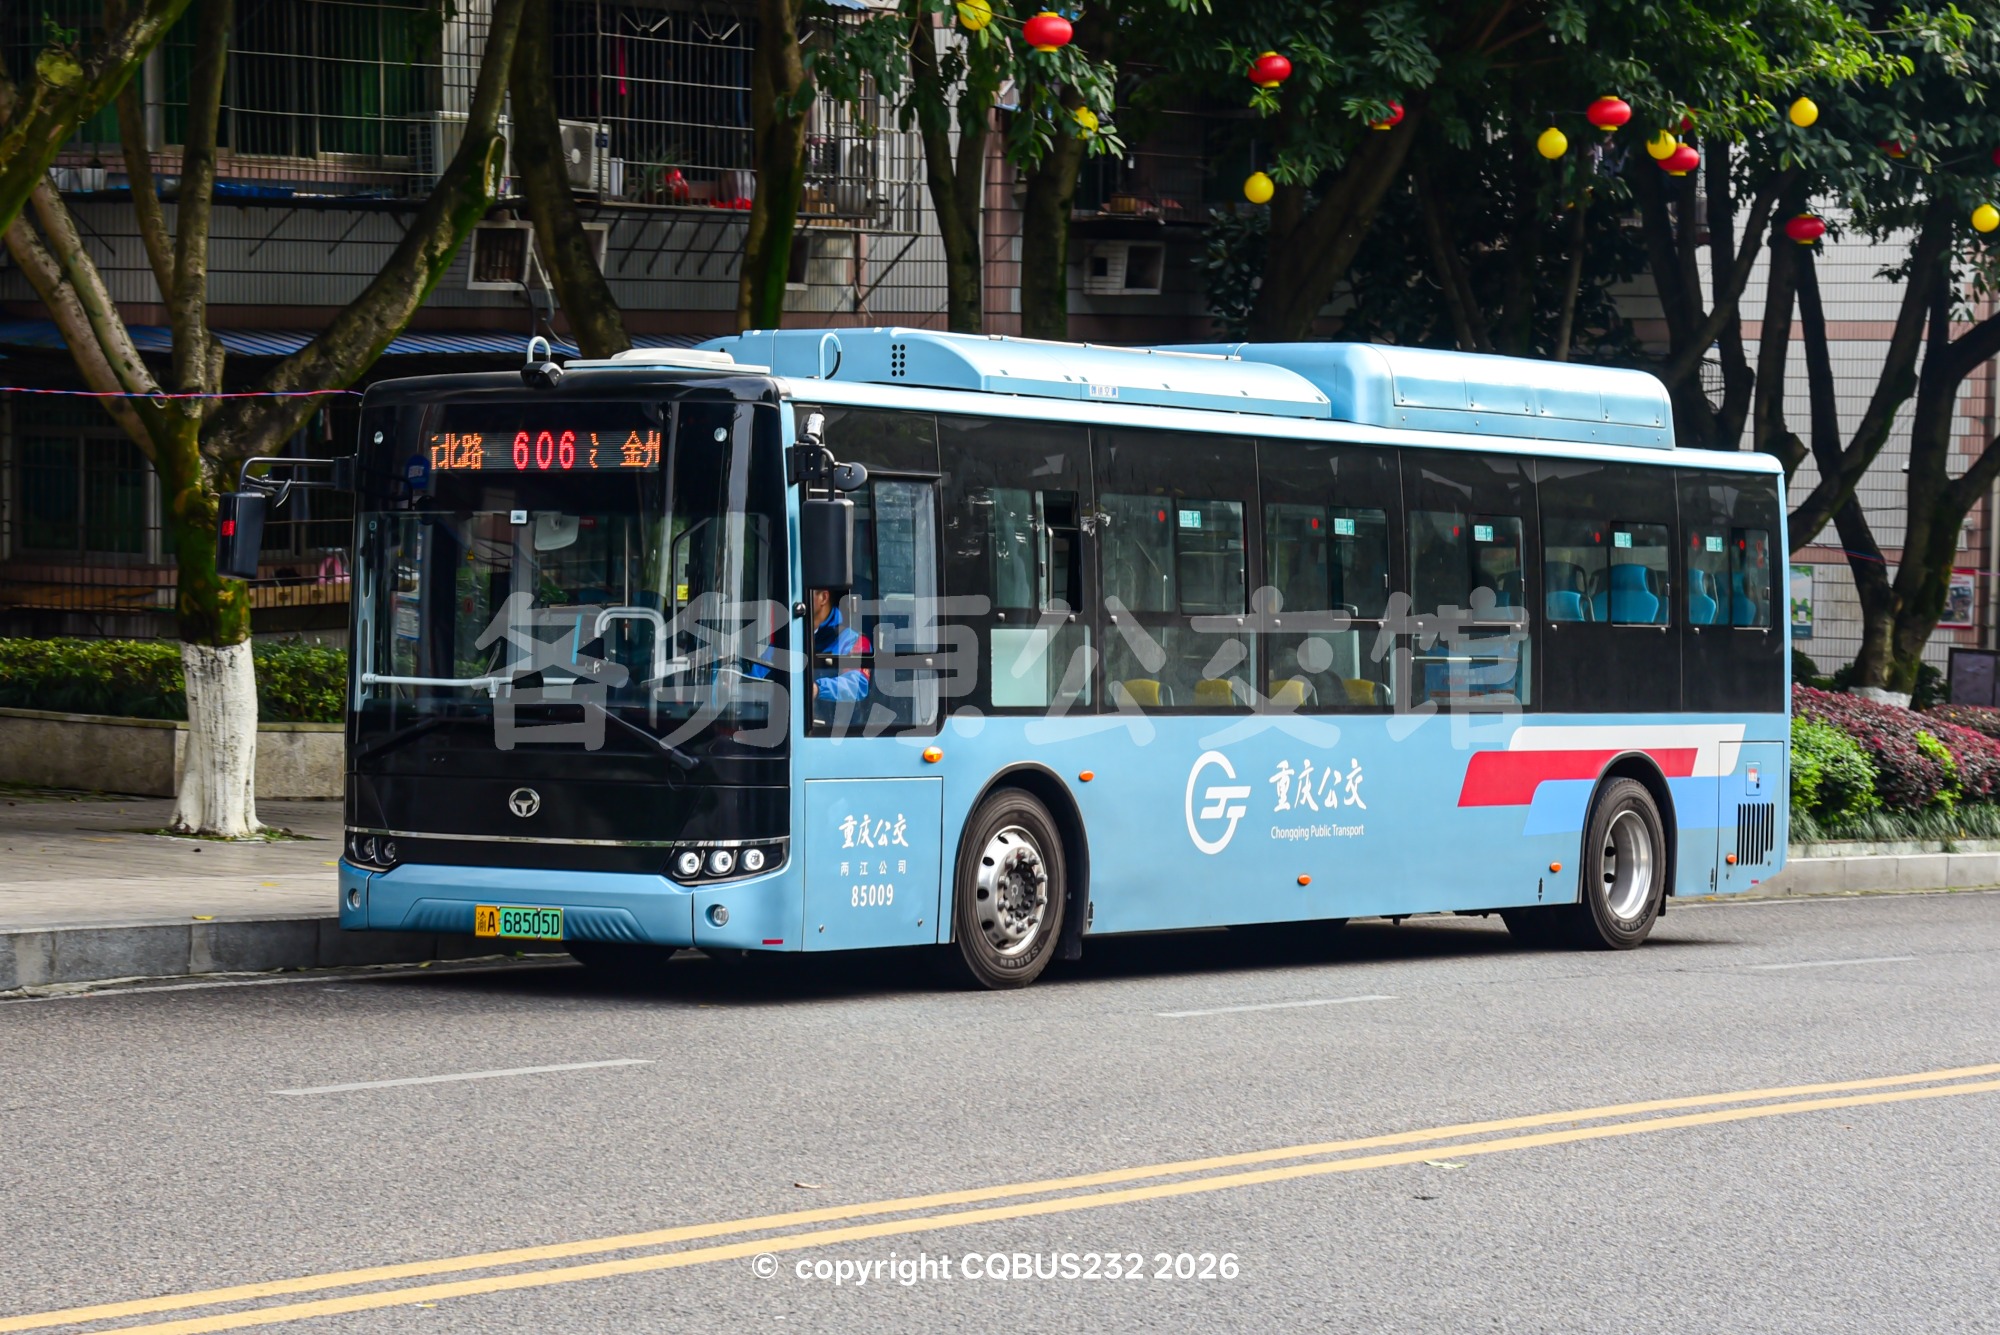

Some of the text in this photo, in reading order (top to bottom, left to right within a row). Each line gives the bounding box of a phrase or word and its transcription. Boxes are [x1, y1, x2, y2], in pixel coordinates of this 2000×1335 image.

[513, 431, 576, 470] 606
[1269, 758, 1367, 812] 重庆公交
[839, 813, 909, 849] 重庆公交
[1270, 823, 1364, 841] Chongqing Public Transport
[840, 860, 906, 876] 两江公司
[851, 884, 894, 907] 85009
[1000, 946, 1039, 968] SAILUN
